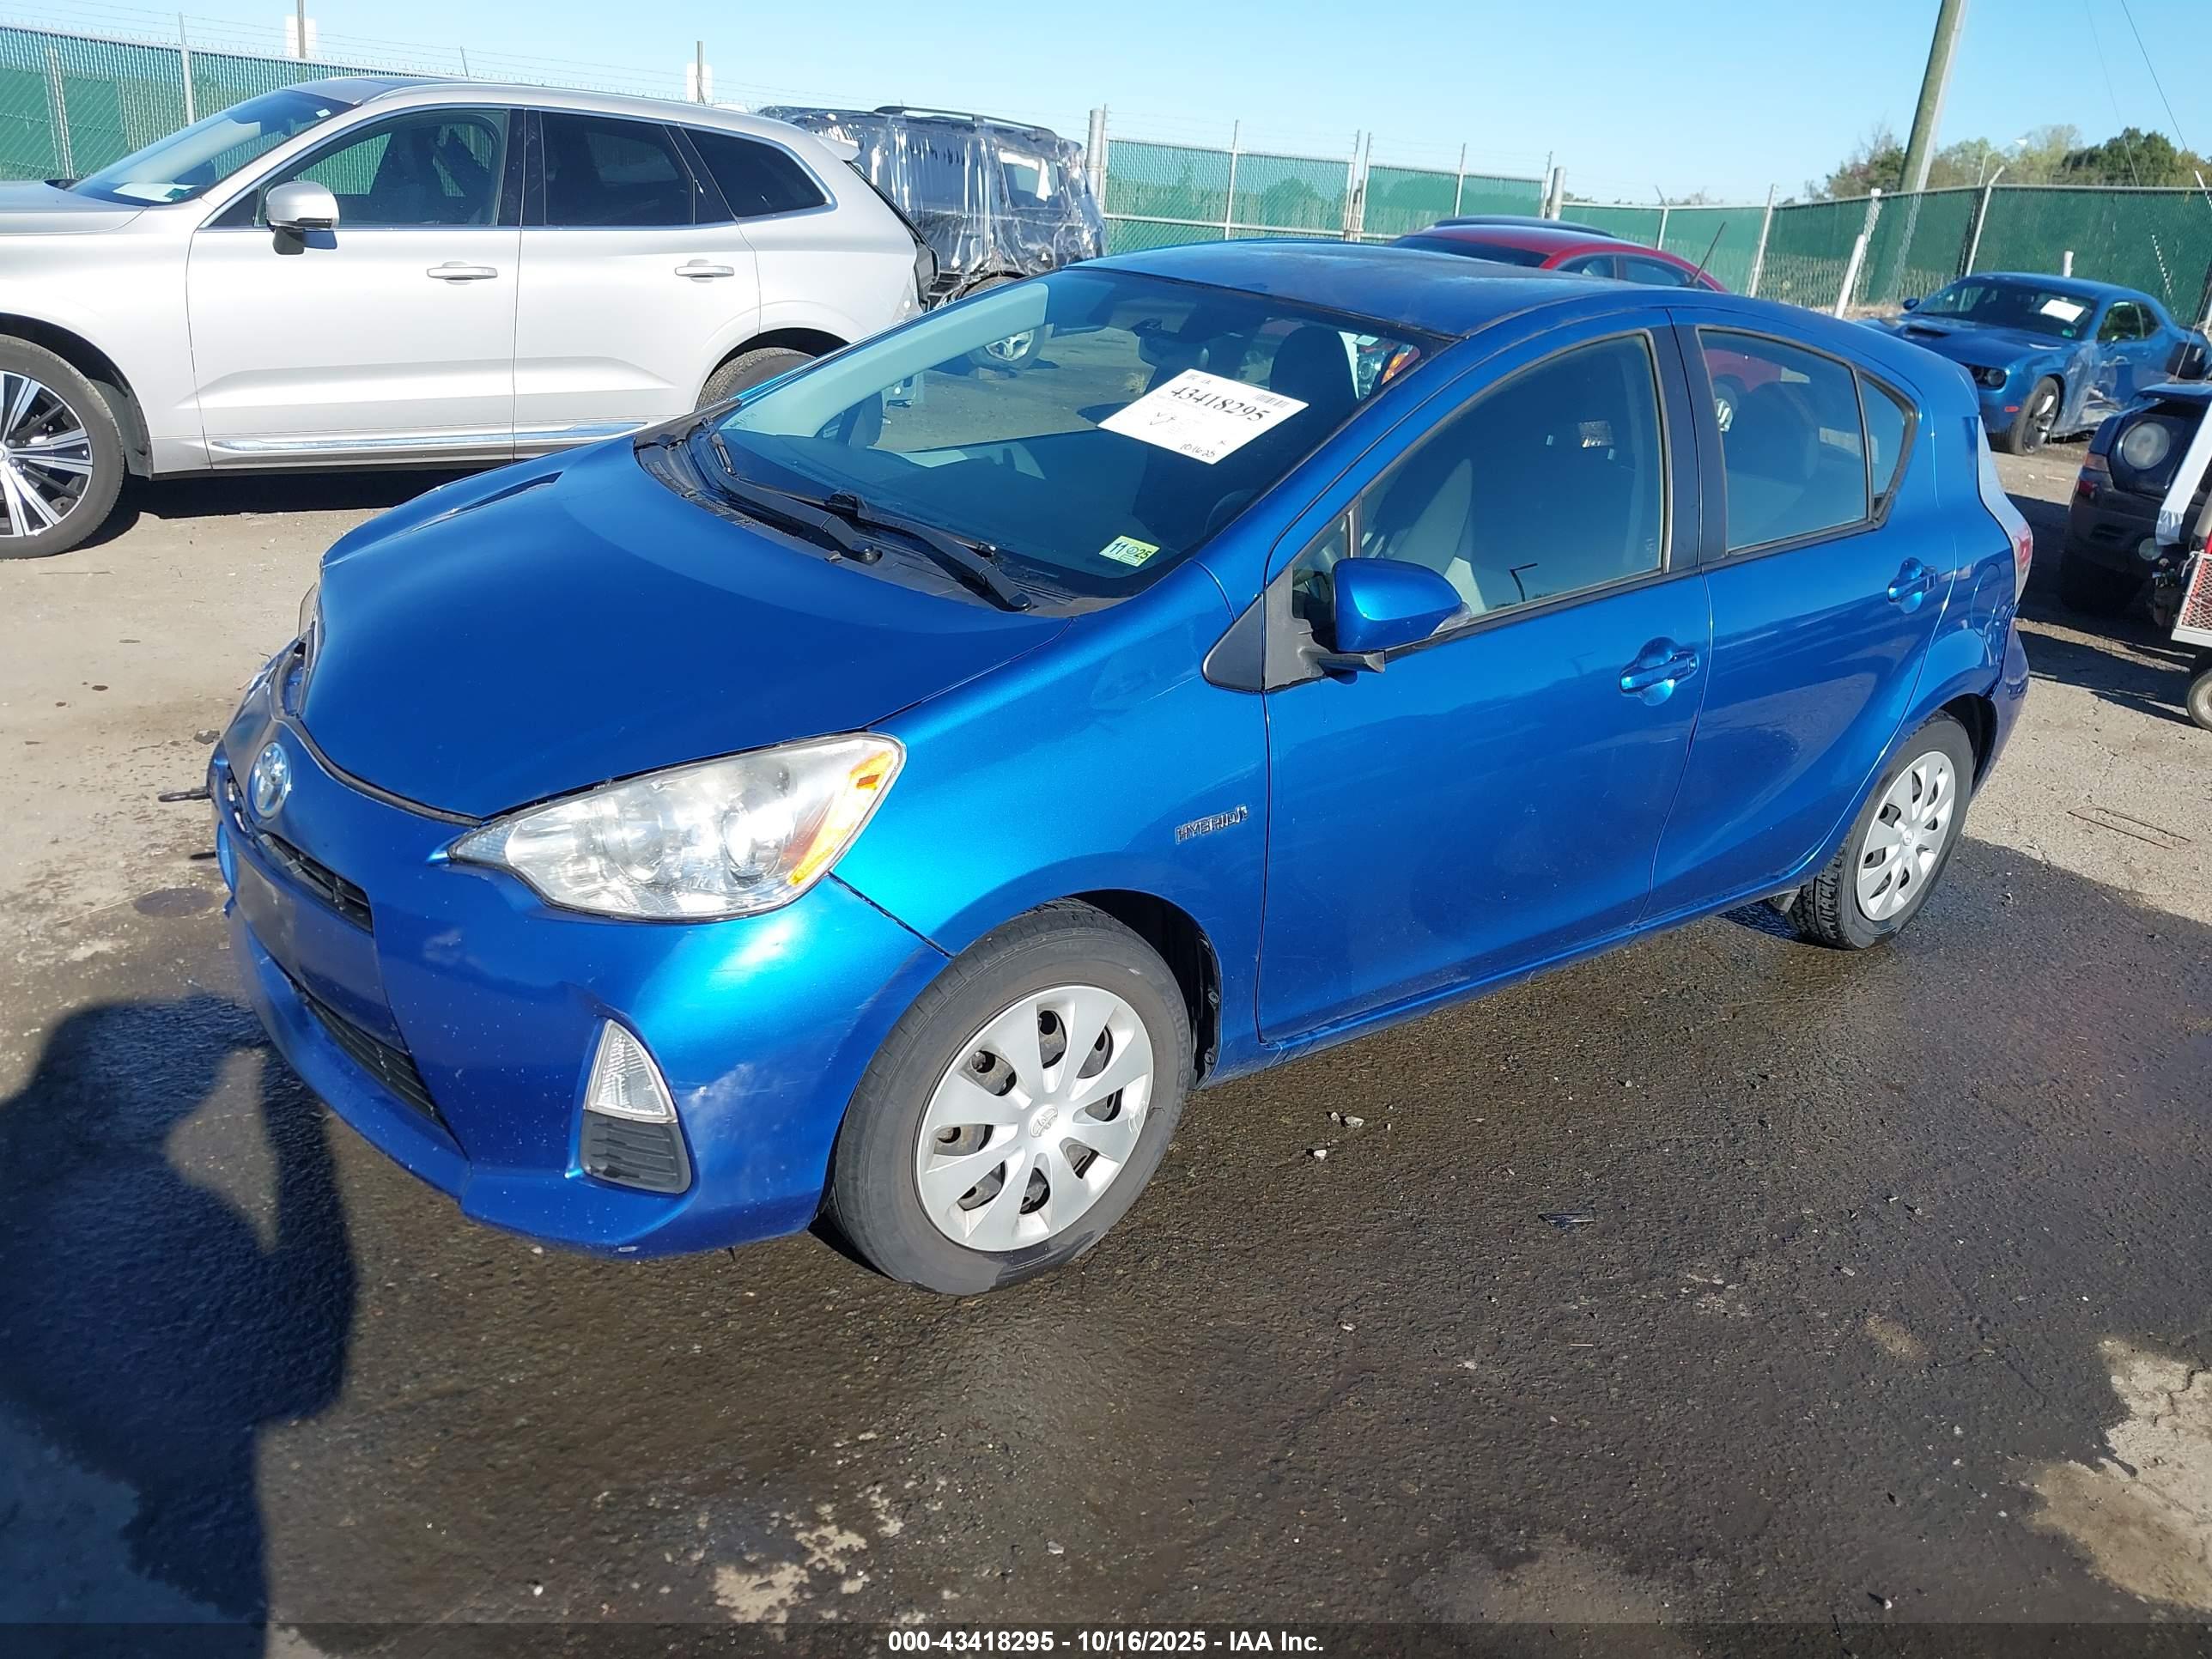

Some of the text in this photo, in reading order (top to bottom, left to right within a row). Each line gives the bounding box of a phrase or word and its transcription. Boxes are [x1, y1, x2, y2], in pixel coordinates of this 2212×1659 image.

[1170, 386, 1273, 422] 43418295
[1109, 542, 1127, 555] 11
[1133, 549, 1152, 560] 25
[1176, 809, 1240, 844] HYBRID
